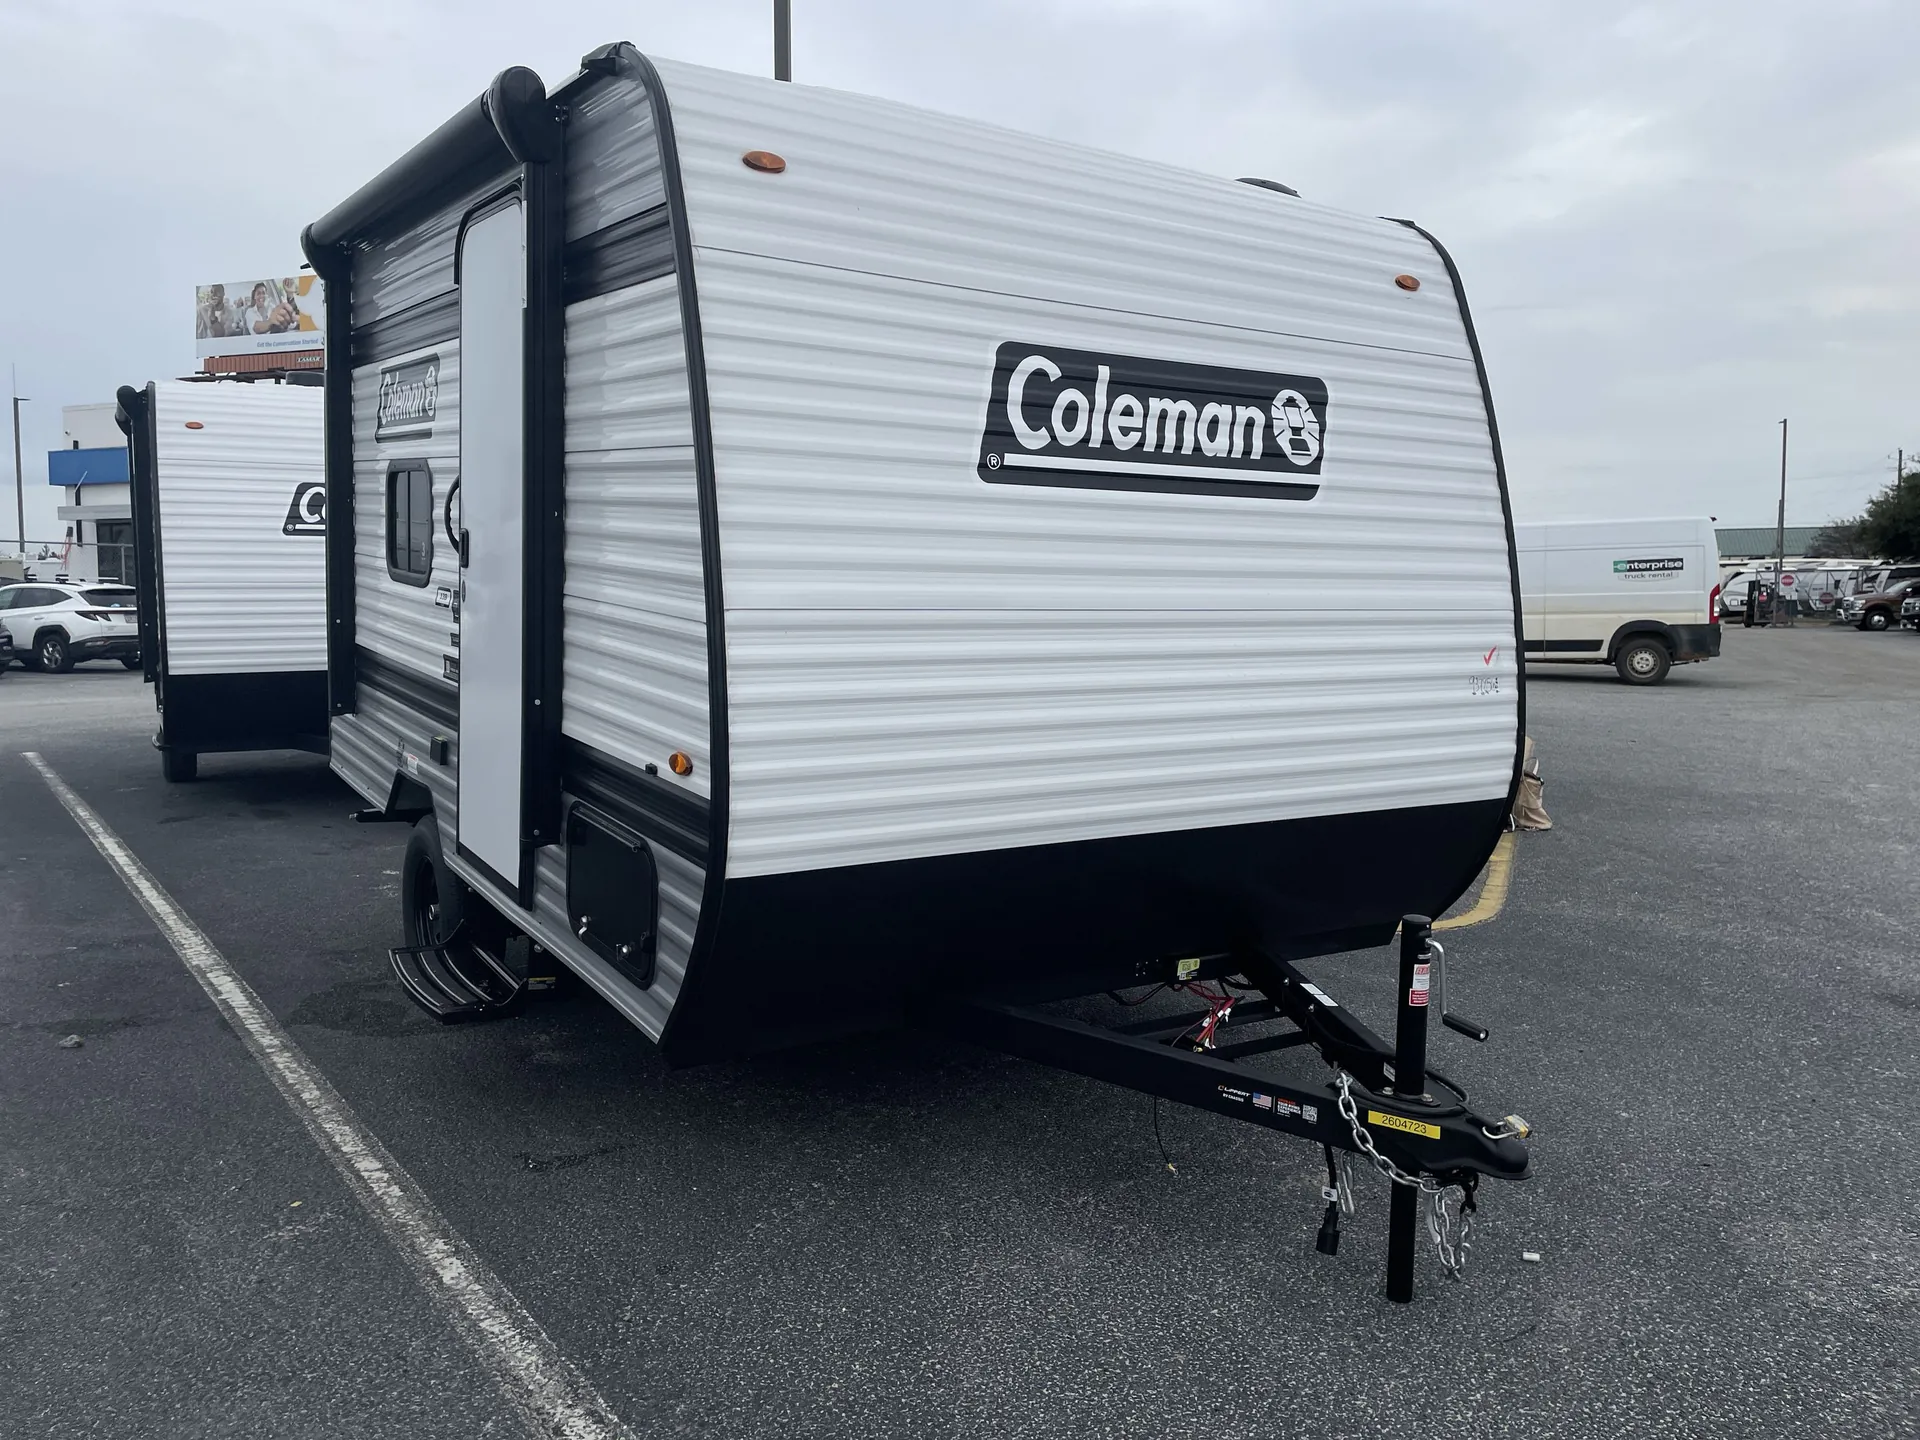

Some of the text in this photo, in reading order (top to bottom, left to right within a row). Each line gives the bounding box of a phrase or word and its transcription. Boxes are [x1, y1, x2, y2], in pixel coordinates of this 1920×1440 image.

[381, 371, 425, 425] Coleman
[1006, 355, 1266, 460] Coleman
[1614, 560, 1683, 571] enterprise
[1381, 1115, 1427, 1134] 2604723
